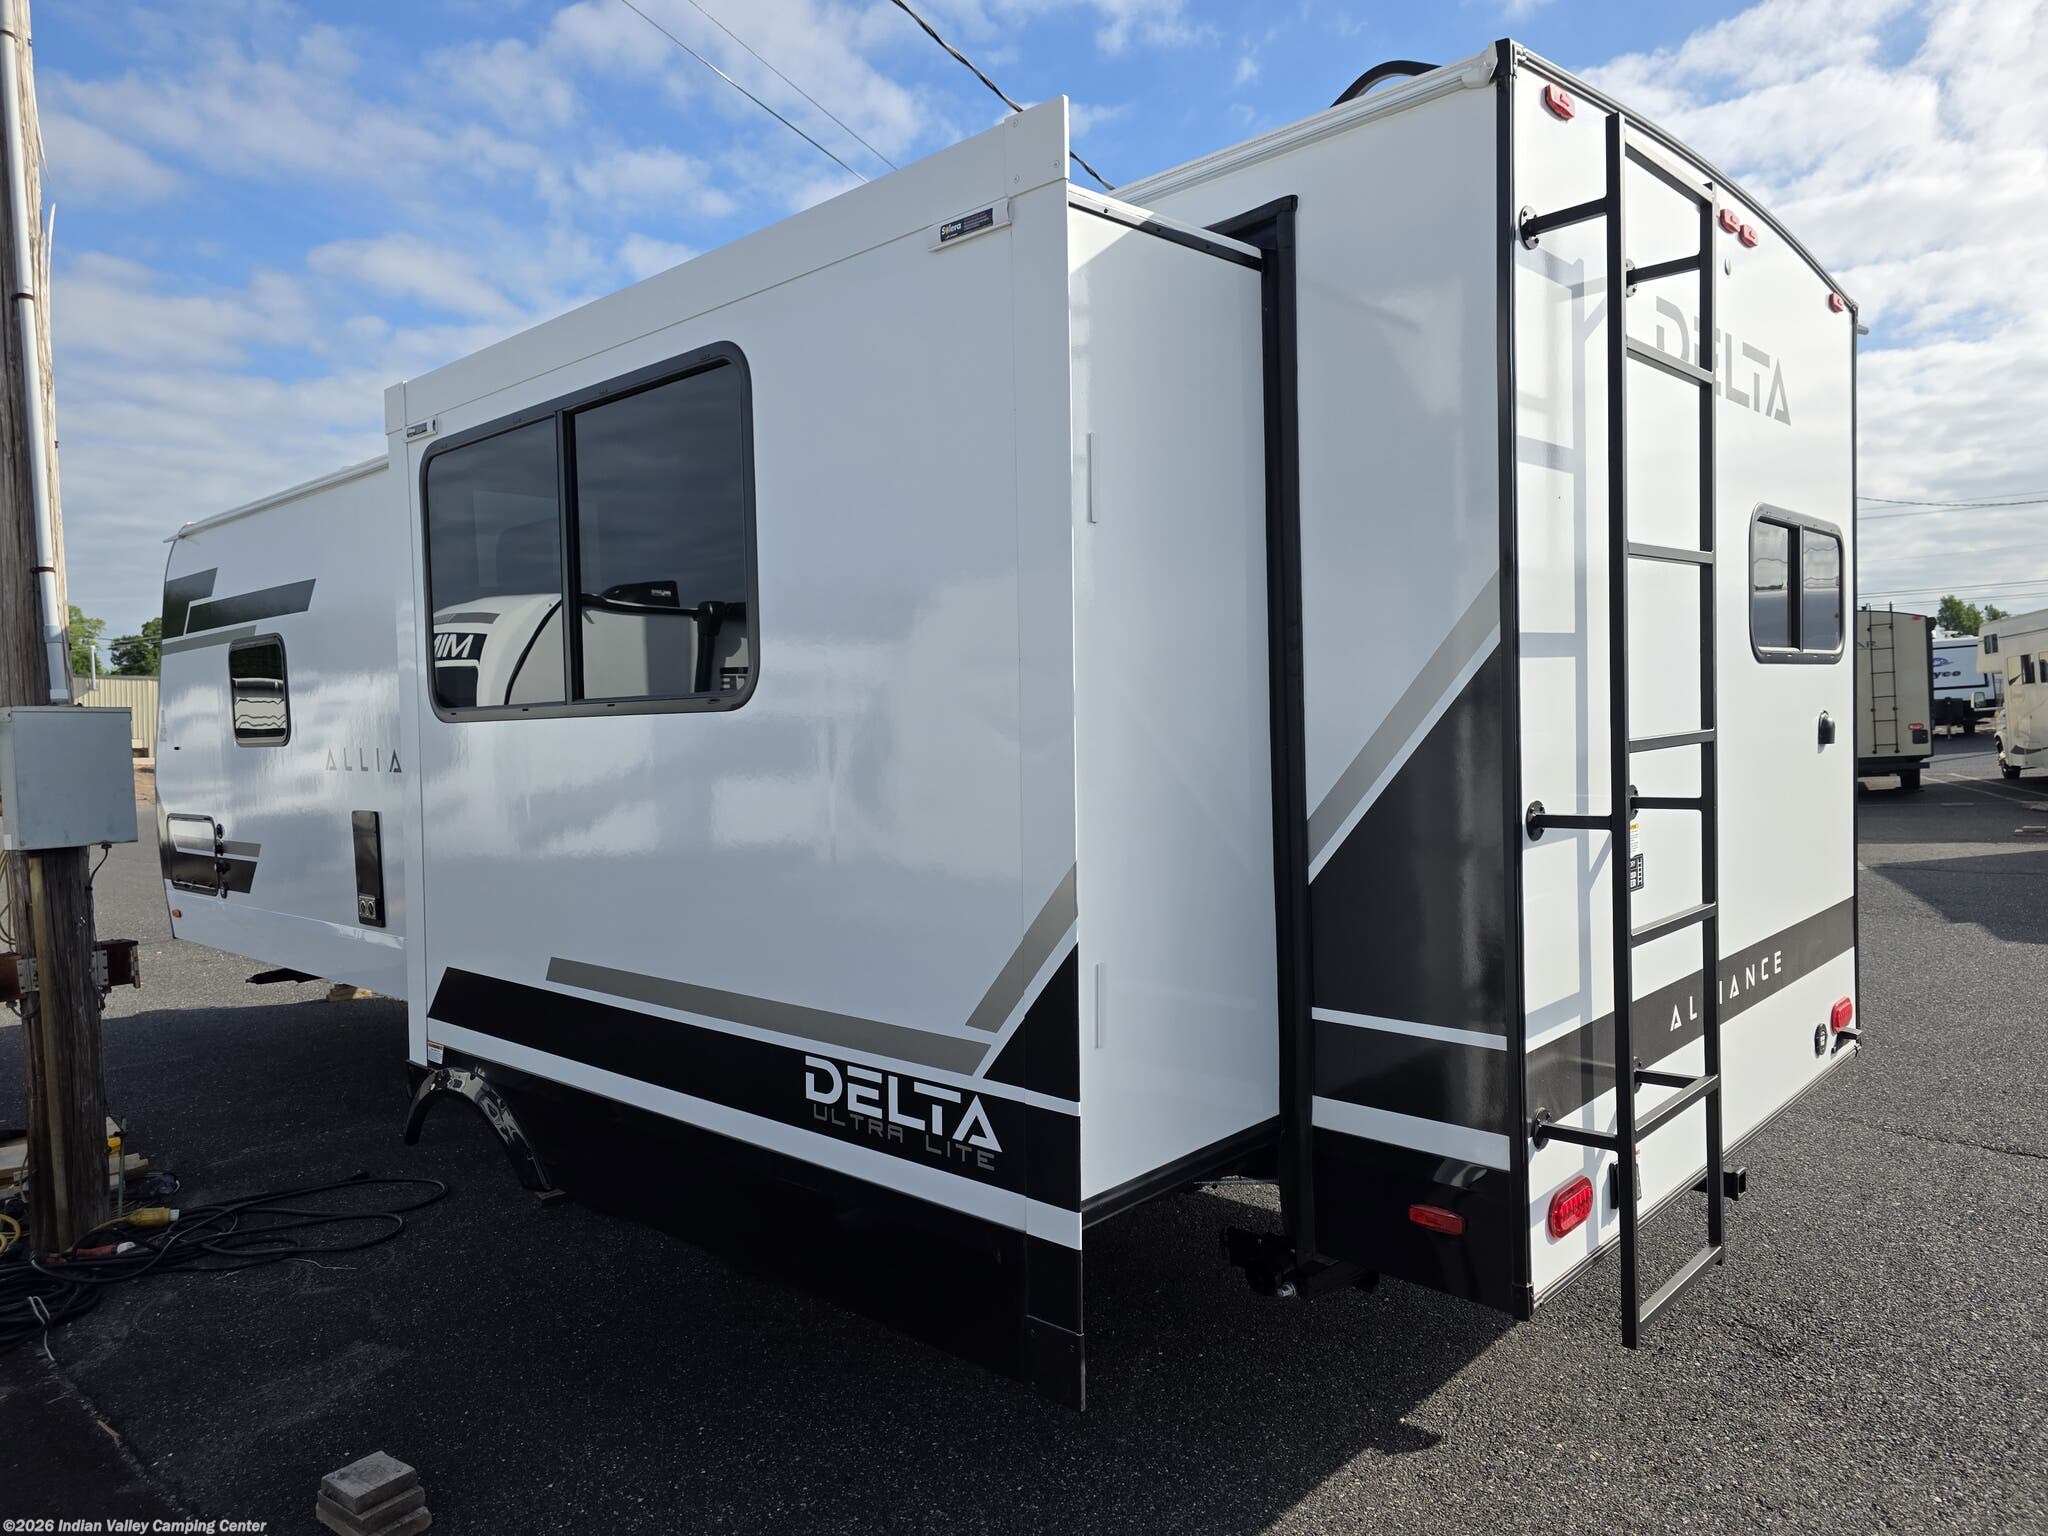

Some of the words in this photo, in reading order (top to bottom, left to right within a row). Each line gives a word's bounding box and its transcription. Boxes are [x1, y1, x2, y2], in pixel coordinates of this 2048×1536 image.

[941, 223, 962, 235] Solera
[1669, 950, 1782, 1032] ALIANCE
[805, 1055, 1003, 1153] DELTA
[813, 1103, 904, 1144] ULTRA
[925, 1134, 995, 1171] LITE
